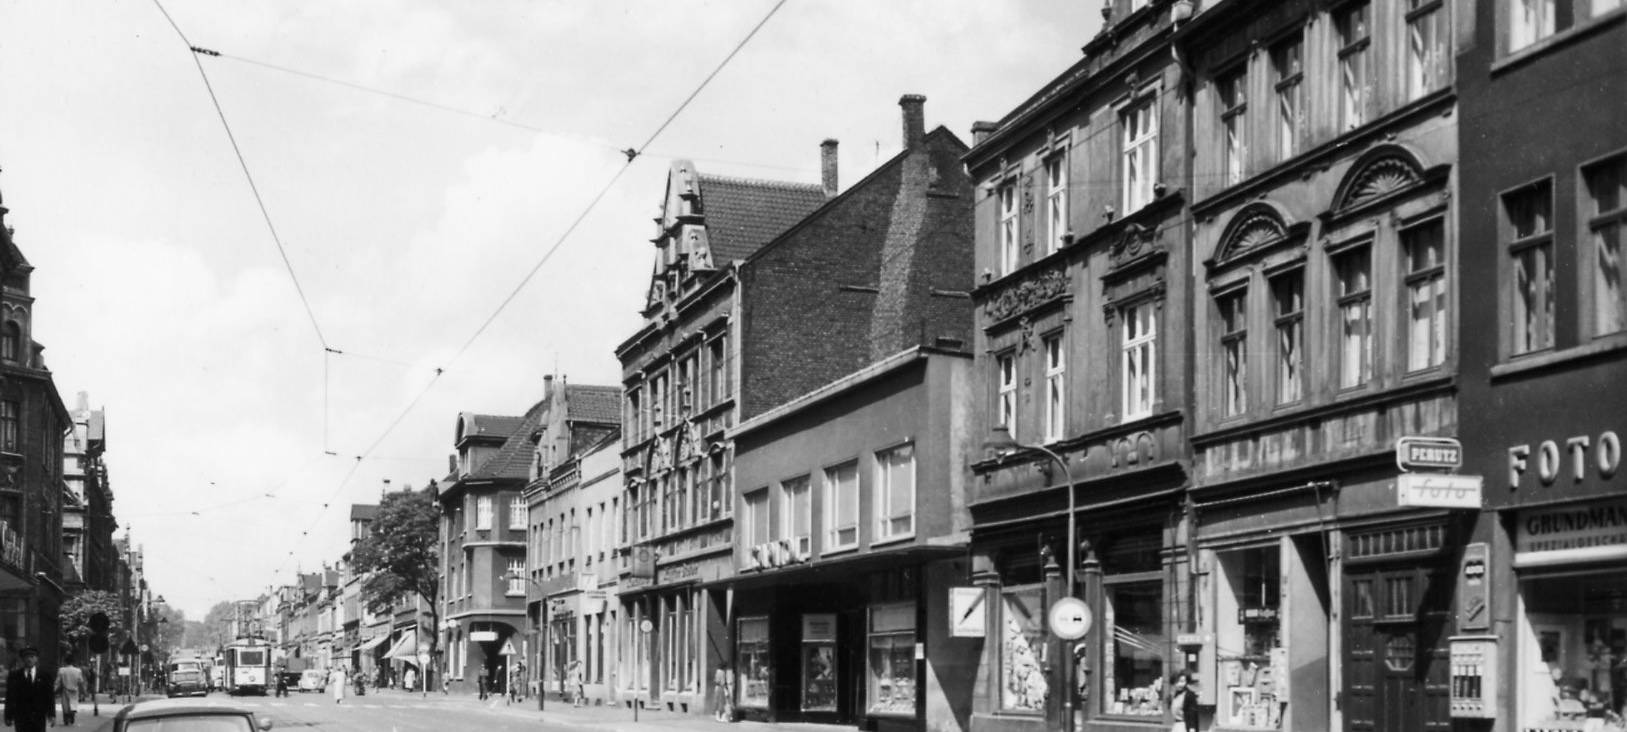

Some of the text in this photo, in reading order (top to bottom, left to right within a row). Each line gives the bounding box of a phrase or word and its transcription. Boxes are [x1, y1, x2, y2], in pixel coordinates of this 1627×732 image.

[1410, 447, 1458, 463] PERUTZ
[1508, 430, 1621, 488] FOTO
[1413, 478, 1476, 500] foto
